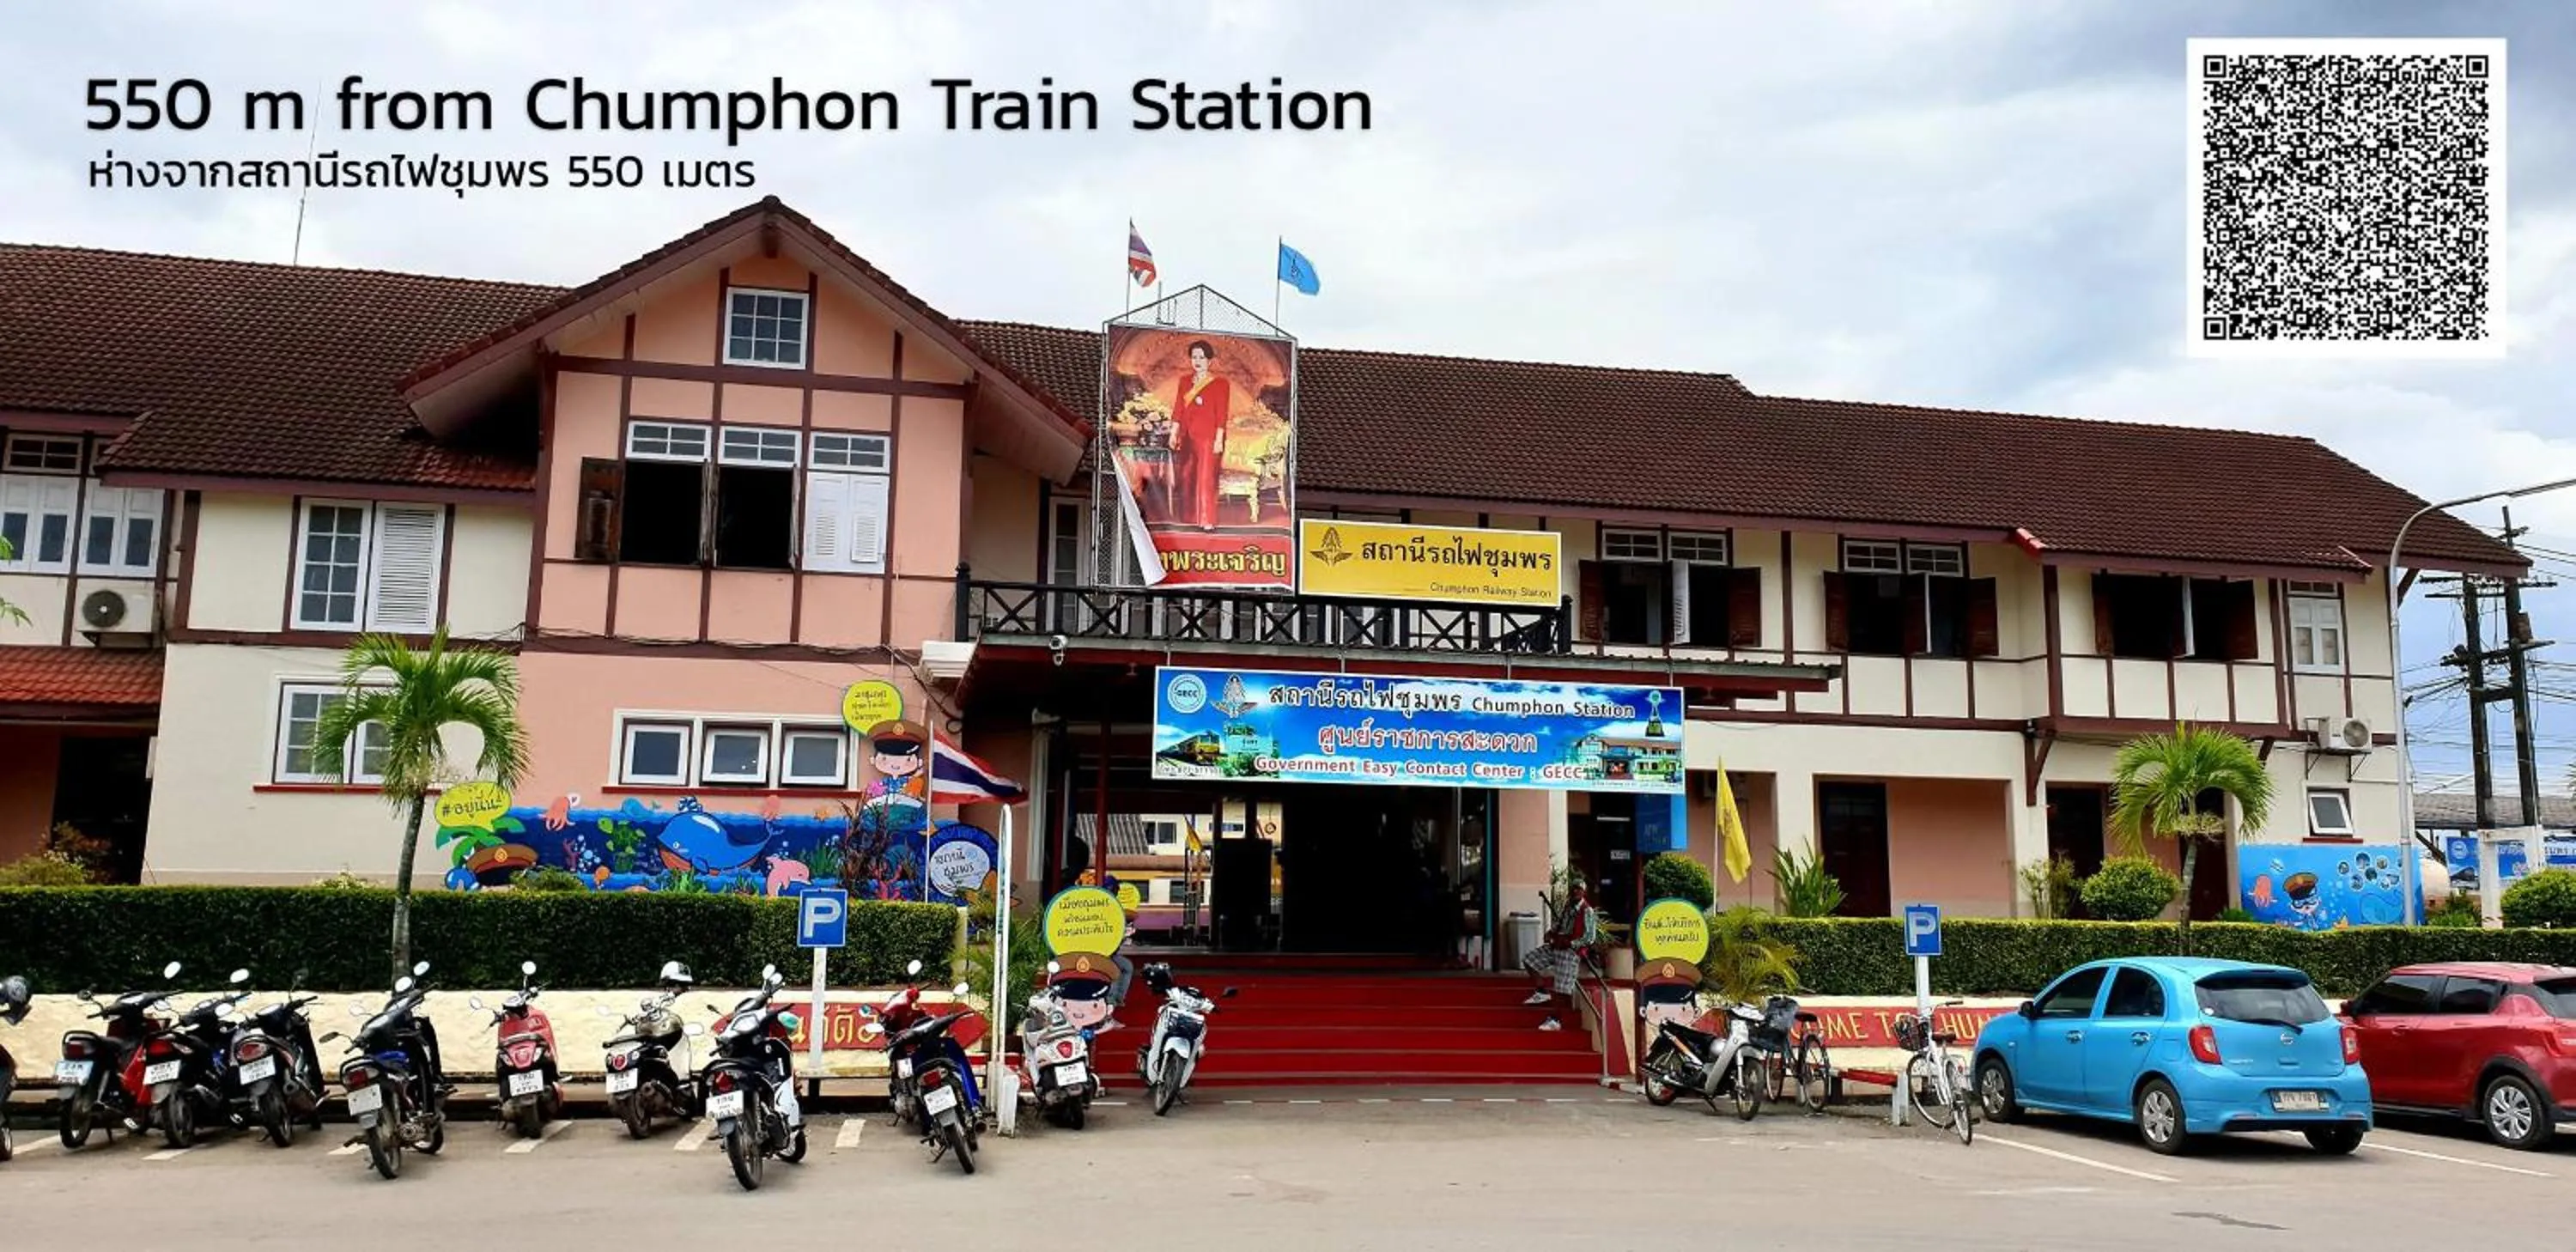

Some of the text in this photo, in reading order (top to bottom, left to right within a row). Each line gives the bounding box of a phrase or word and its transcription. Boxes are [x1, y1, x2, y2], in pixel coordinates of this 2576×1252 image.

[1361, 536, 1552, 578] สถานีรถไฟชุมพร
[1430, 581, 1552, 599] Chumphon Railway Station
[1269, 680, 1635, 719] สถานีรถไฟชุมพร Chumphon Station
[1319, 718, 1538, 753] ศูนย์ราชการสะดวก
[1255, 756, 1356, 774] Government
[1363, 759, 1398, 776] Easy
[1406, 761, 1467, 777] Contact
[1473, 763, 1523, 778] Center
[1542, 764, 1583, 779] GECC
[804, 897, 842, 939] P
[1908, 911, 1936, 947] P
